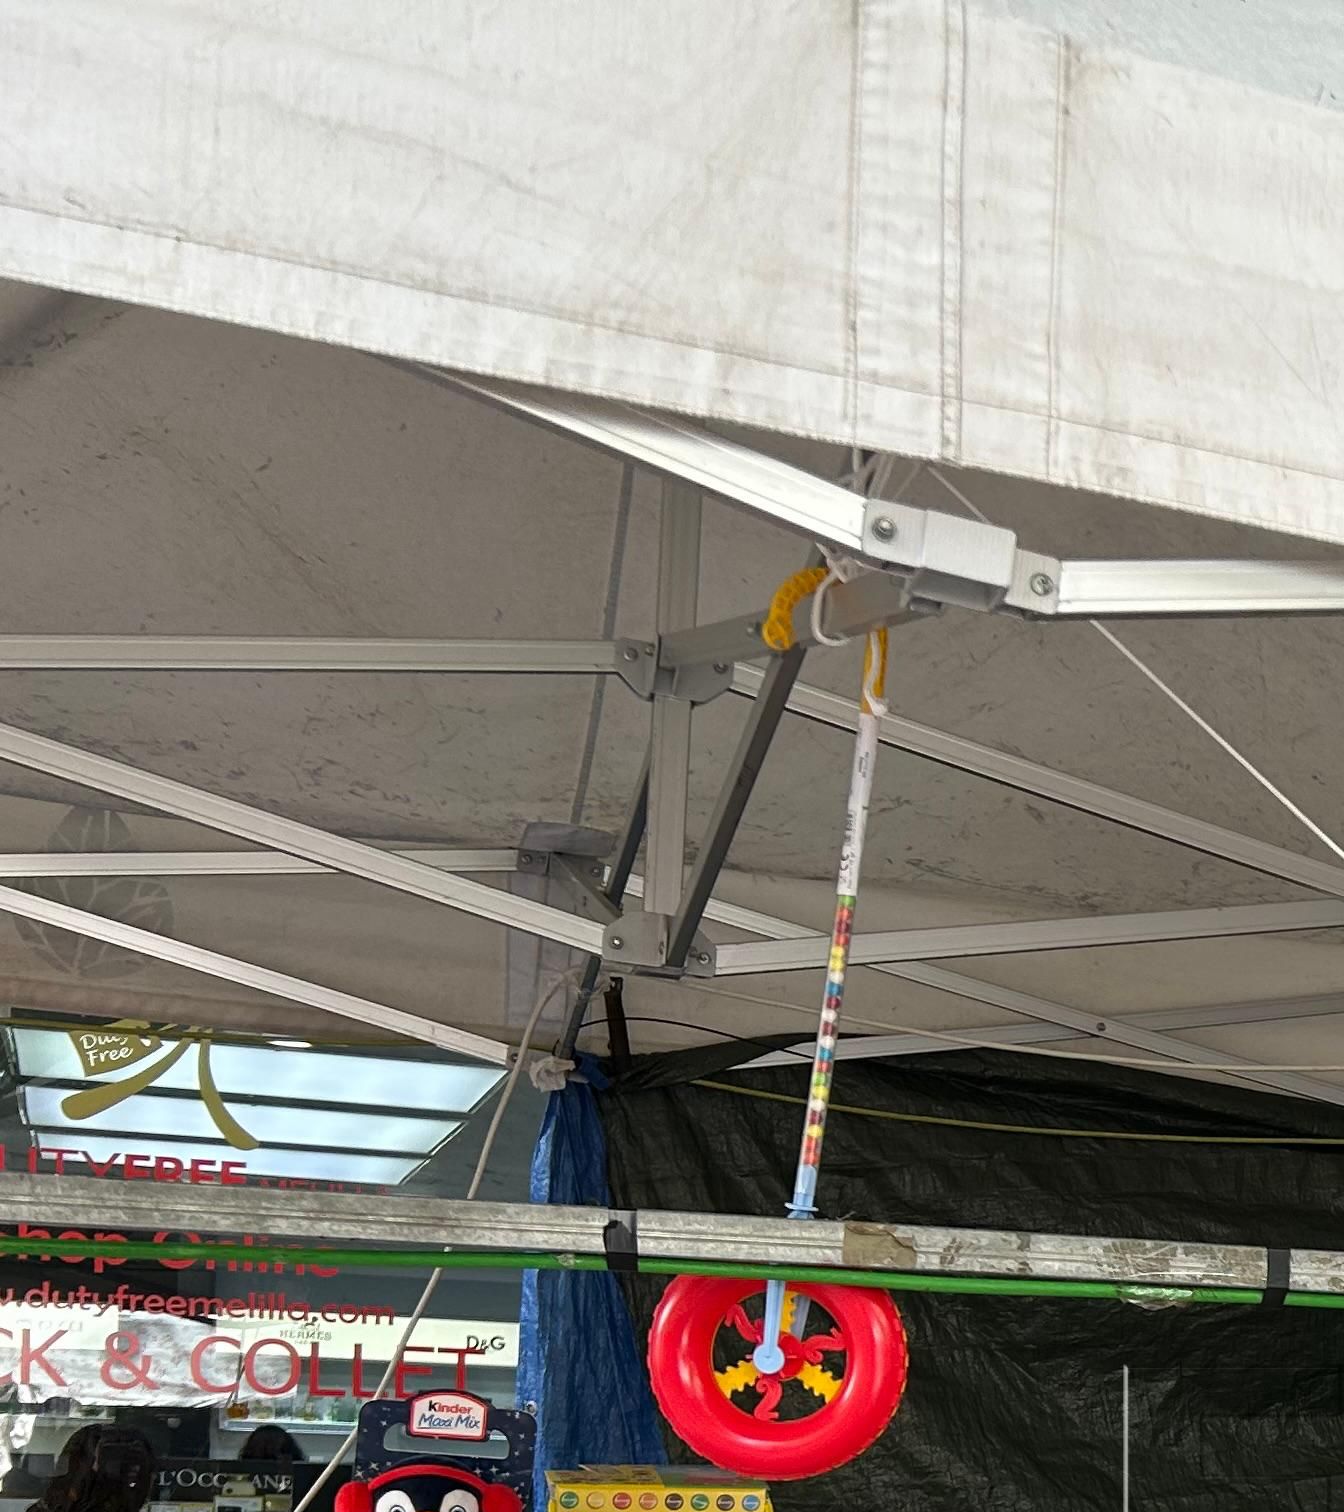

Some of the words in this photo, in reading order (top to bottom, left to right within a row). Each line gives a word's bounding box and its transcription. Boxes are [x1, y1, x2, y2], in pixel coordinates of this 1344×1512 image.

[86, 1046, 134, 1067] Free
[0, 1223, 128, 1274] hop
[0, 1327, 69, 1387] K
[100, 1330, 160, 1391] &
[456, 1415, 481, 1430] Mix
